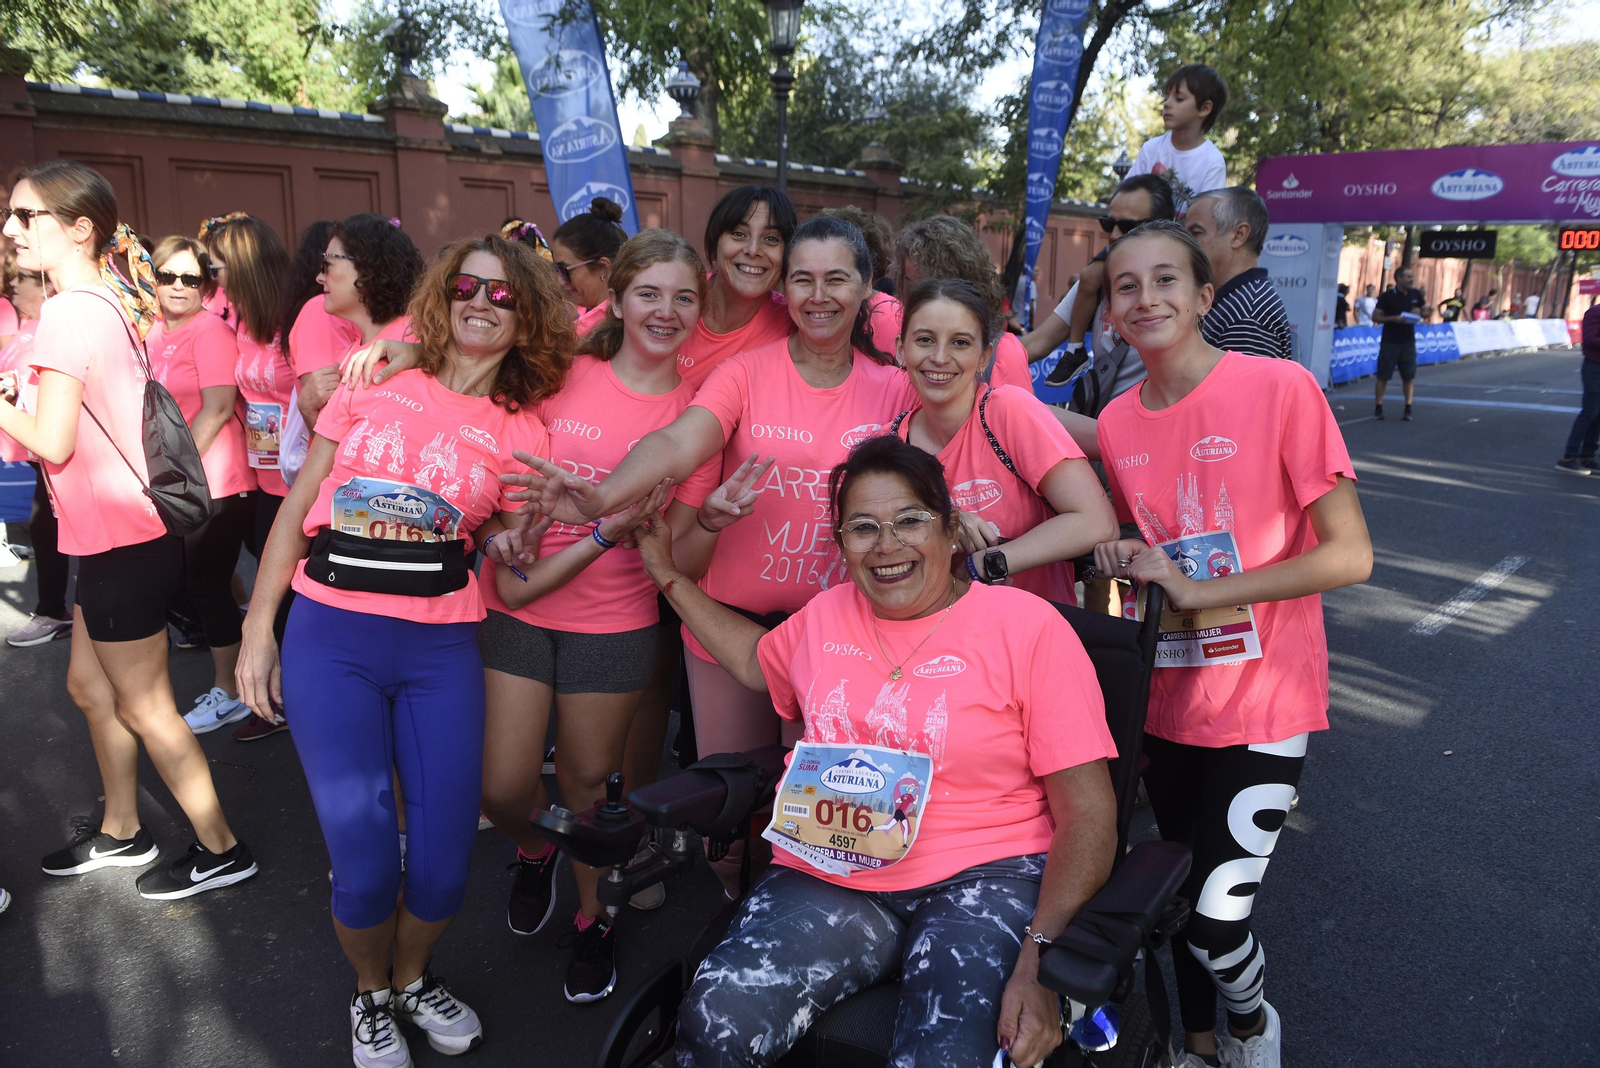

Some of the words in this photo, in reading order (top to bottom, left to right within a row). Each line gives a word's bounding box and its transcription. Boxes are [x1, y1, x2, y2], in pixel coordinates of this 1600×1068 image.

[1557, 158, 1600, 171] ASTURI
[1266, 189, 1313, 200] Santander
[1343, 183, 1397, 197] OYSHO
[1436, 180, 1498, 194] ASTURIANA
[1430, 239, 1486, 252] OYSHO
[1268, 275, 1307, 289] YSHO
[375, 390, 424, 413] OYSHO
[461, 427, 498, 454] ASTURIANA
[751, 423, 813, 444] OYSHO
[1194, 445, 1233, 457] ASTURIANA
[341, 491, 363, 500] SUMA
[369, 520, 424, 543] 016
[758, 518, 834, 556] MUJE
[759, 553, 819, 585] 2016
[1196, 627, 1222, 639] MUJER
[822, 641, 873, 661] OYSHO
[1156, 648, 1185, 659] YSHO
[1213, 643, 1240, 653] Santander
[916, 664, 962, 675] ASTURIANA
[798, 763, 819, 772] SUMA
[823, 770, 880, 790] ASTURIANA
[815, 799, 873, 833] 016
[828, 833, 857, 850] 4597
[777, 837, 825, 865] OYSHO
[836, 850, 846, 860] DE
[847, 852, 857, 863] LA
[858, 854, 882, 869] MUJER
